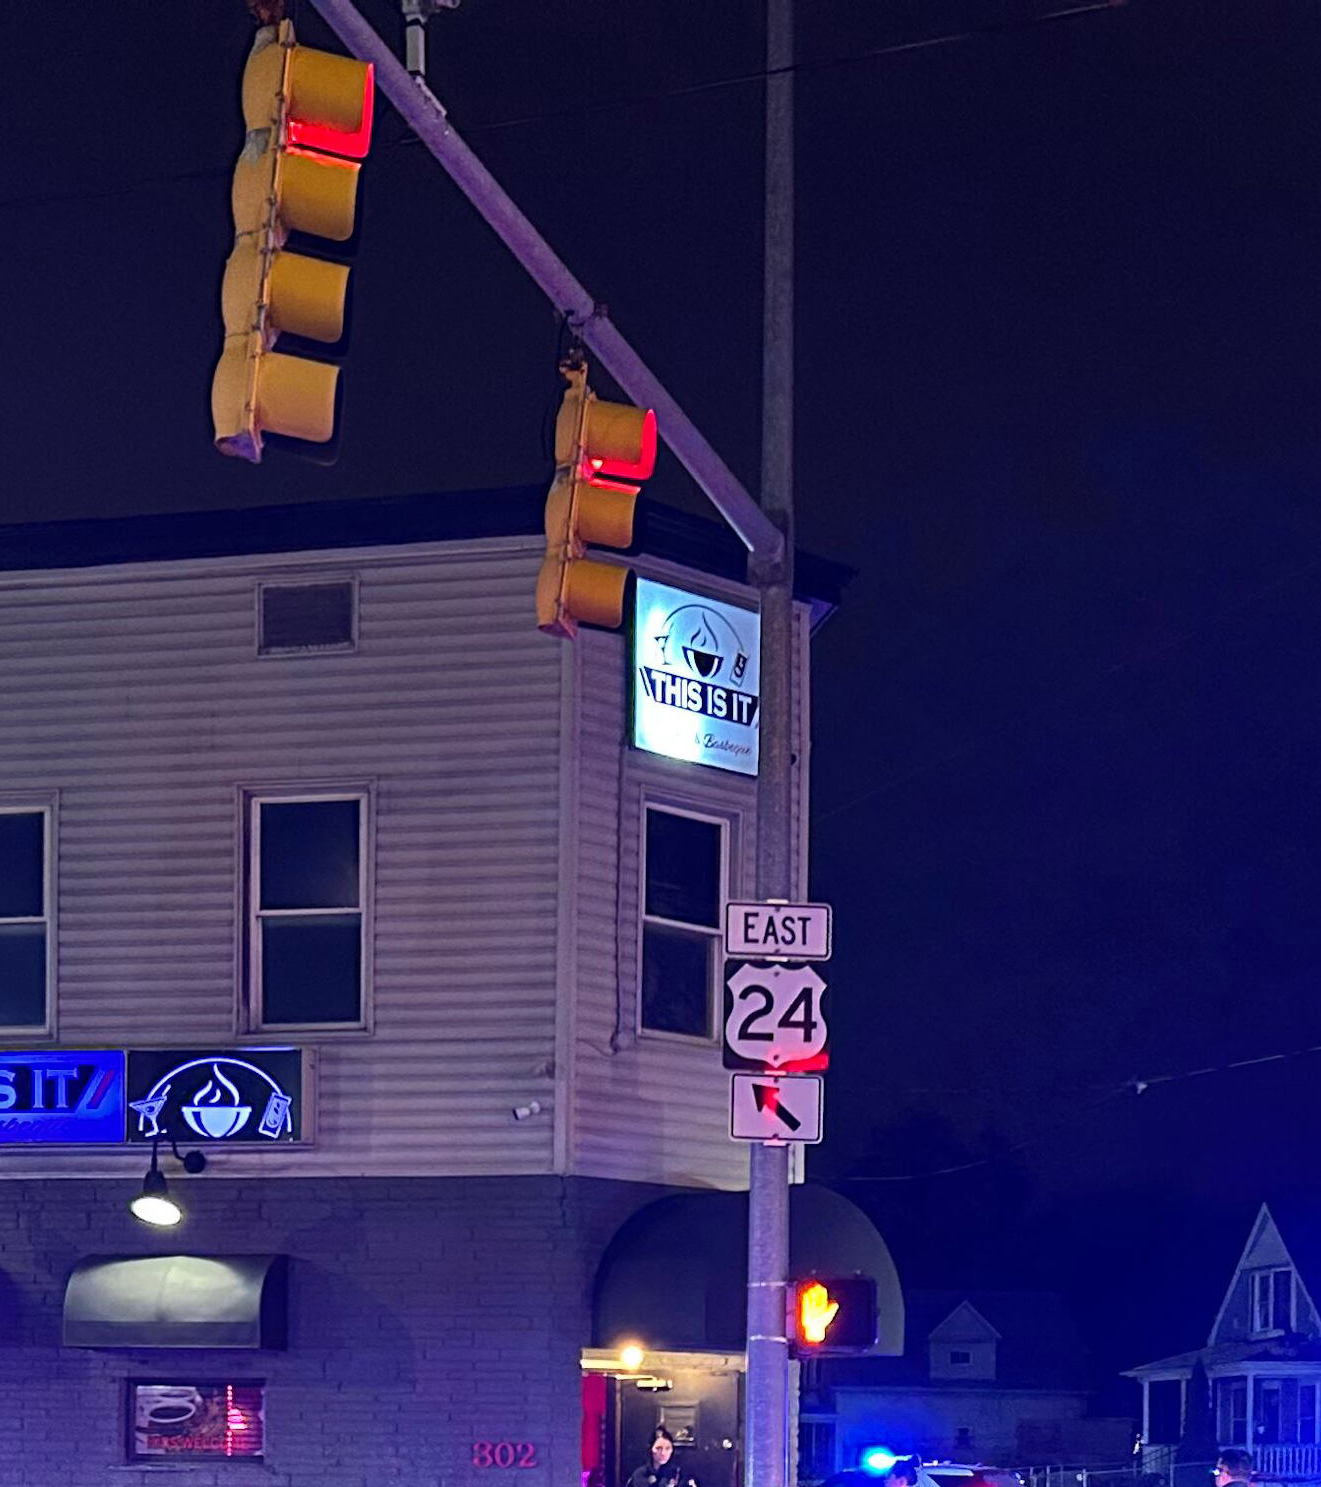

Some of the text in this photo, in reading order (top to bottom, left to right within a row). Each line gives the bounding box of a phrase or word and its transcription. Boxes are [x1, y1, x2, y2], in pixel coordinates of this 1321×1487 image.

[651, 673, 752, 724] THIS IS IT
[743, 912, 811, 945] EAST
[738, 984, 817, 1043] 24
[32, 1068, 78, 1109] IT
[472, 1441, 537, 1468] 302
